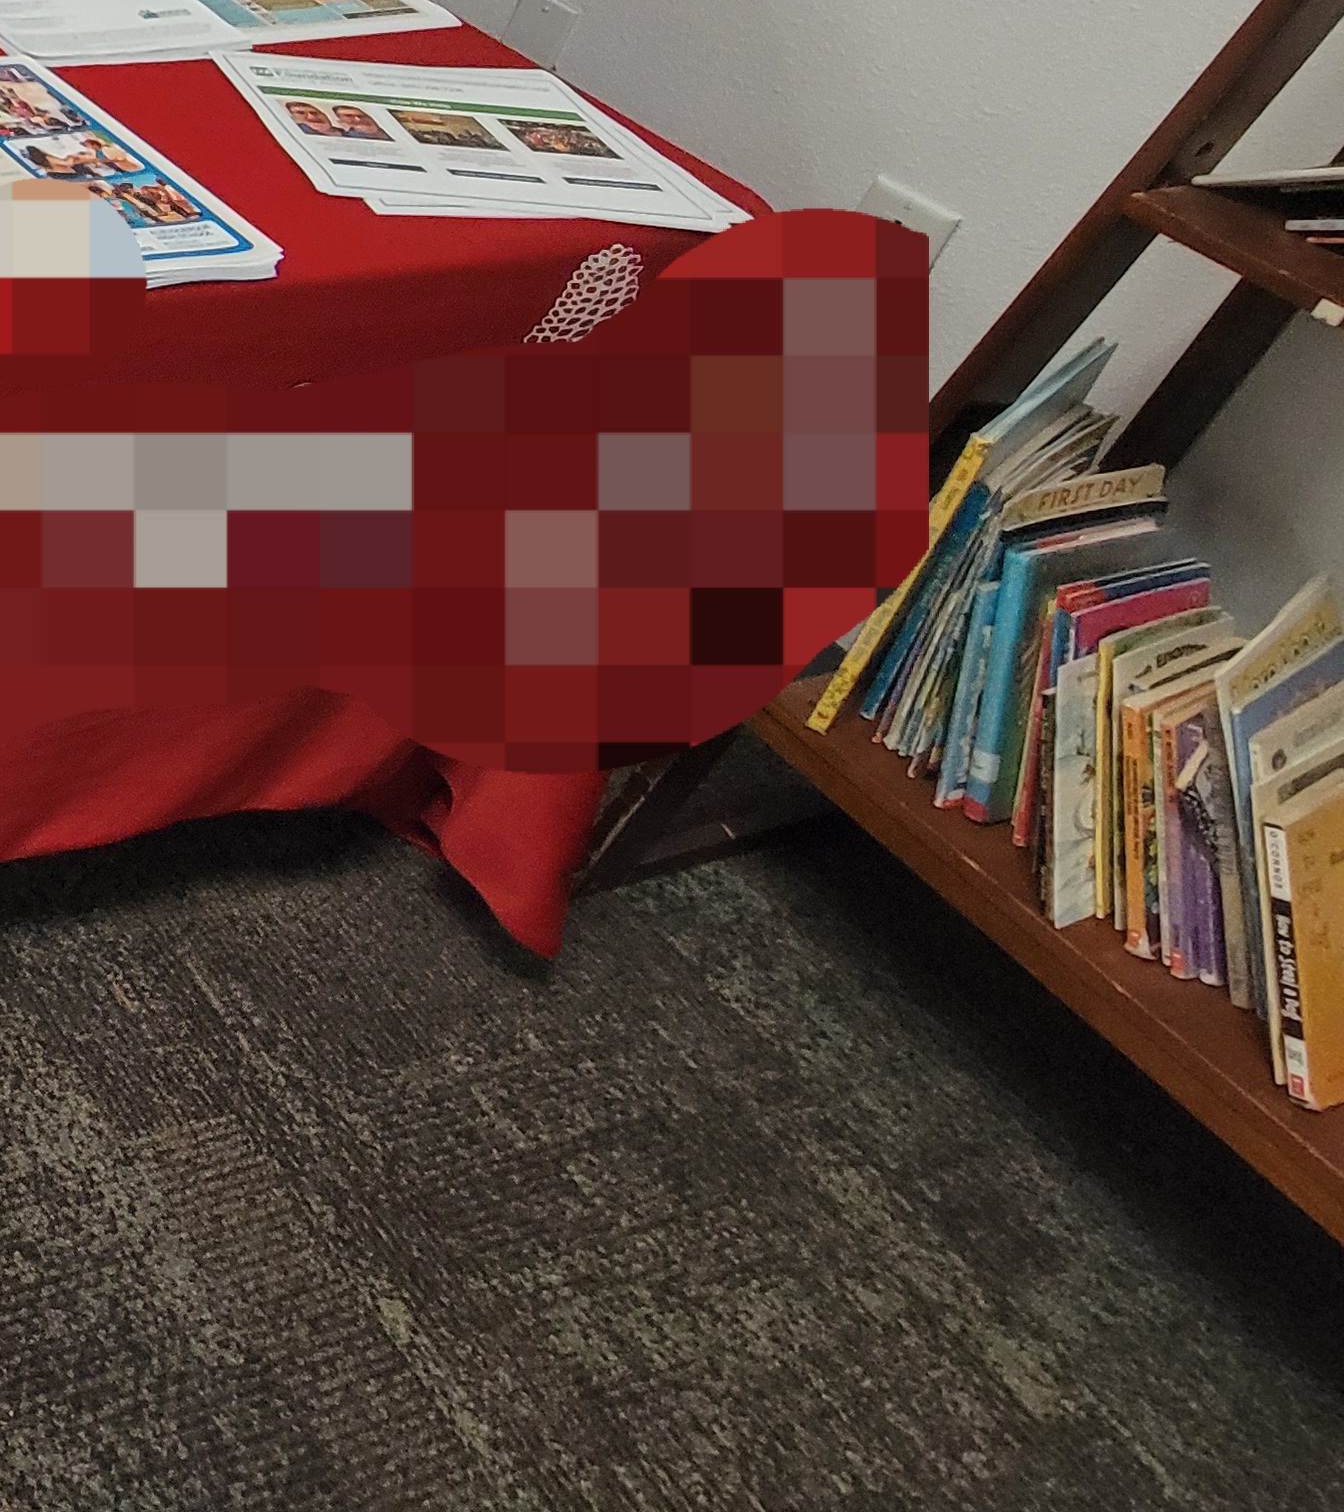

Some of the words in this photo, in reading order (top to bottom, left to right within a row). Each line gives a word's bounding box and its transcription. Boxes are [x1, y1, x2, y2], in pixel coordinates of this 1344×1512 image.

[1038, 483, 1096, 510] FIRST
[1100, 473, 1144, 499] DAY
[1278, 956, 1299, 986] Steal
